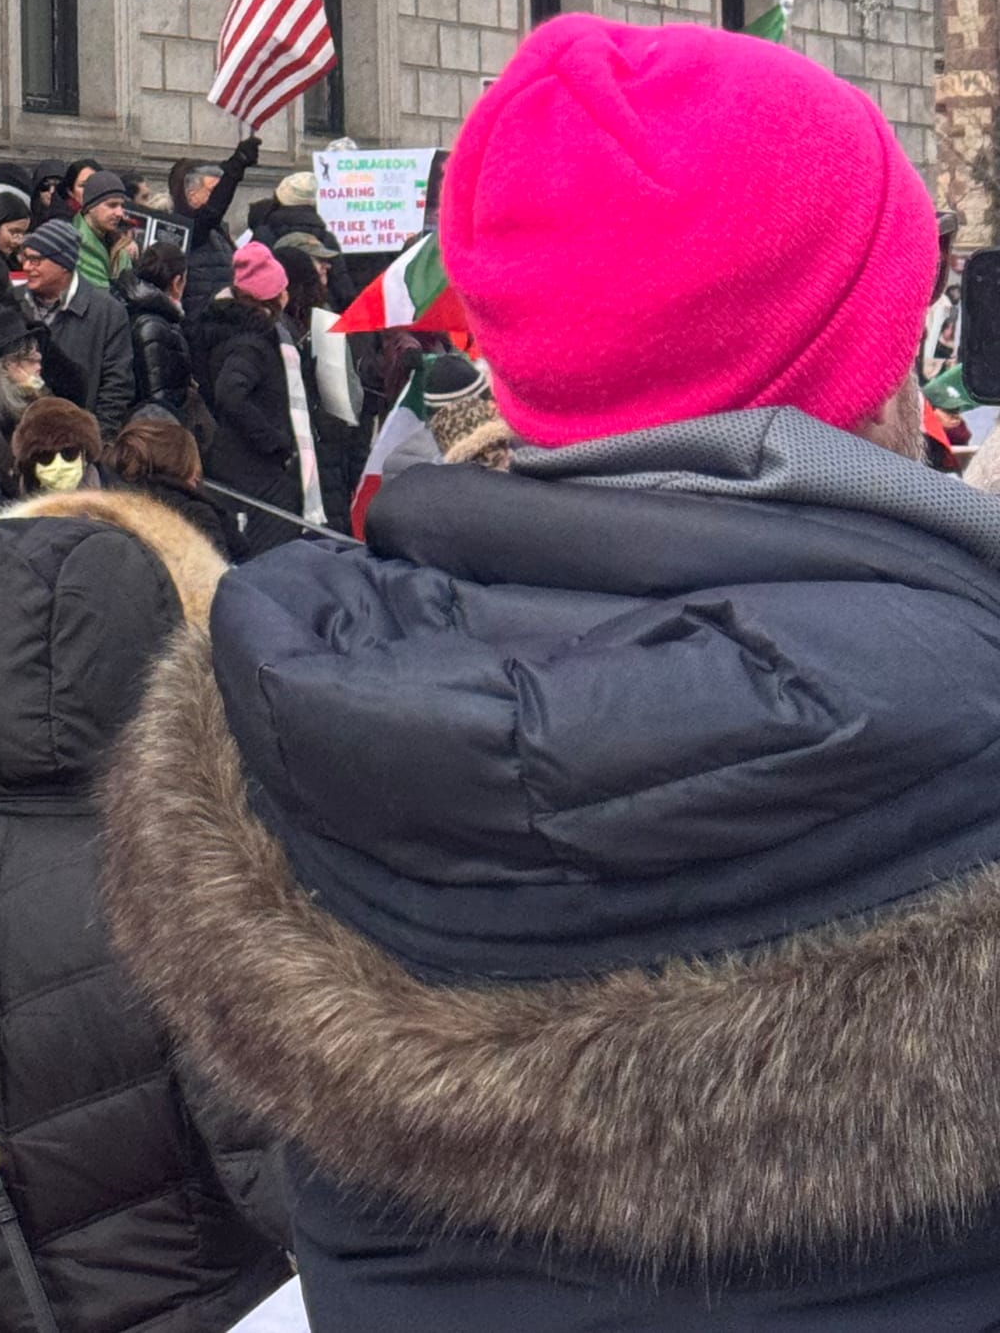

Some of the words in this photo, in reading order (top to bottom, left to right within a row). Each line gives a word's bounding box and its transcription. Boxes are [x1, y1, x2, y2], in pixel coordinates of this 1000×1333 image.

[337, 158, 417, 170] COURAGEOUS
[320, 187, 376, 199] ROARING
[329, 220, 367, 233] TRIKE
[372, 219, 396, 231] THE
[342, 234, 373, 246] AMIC
